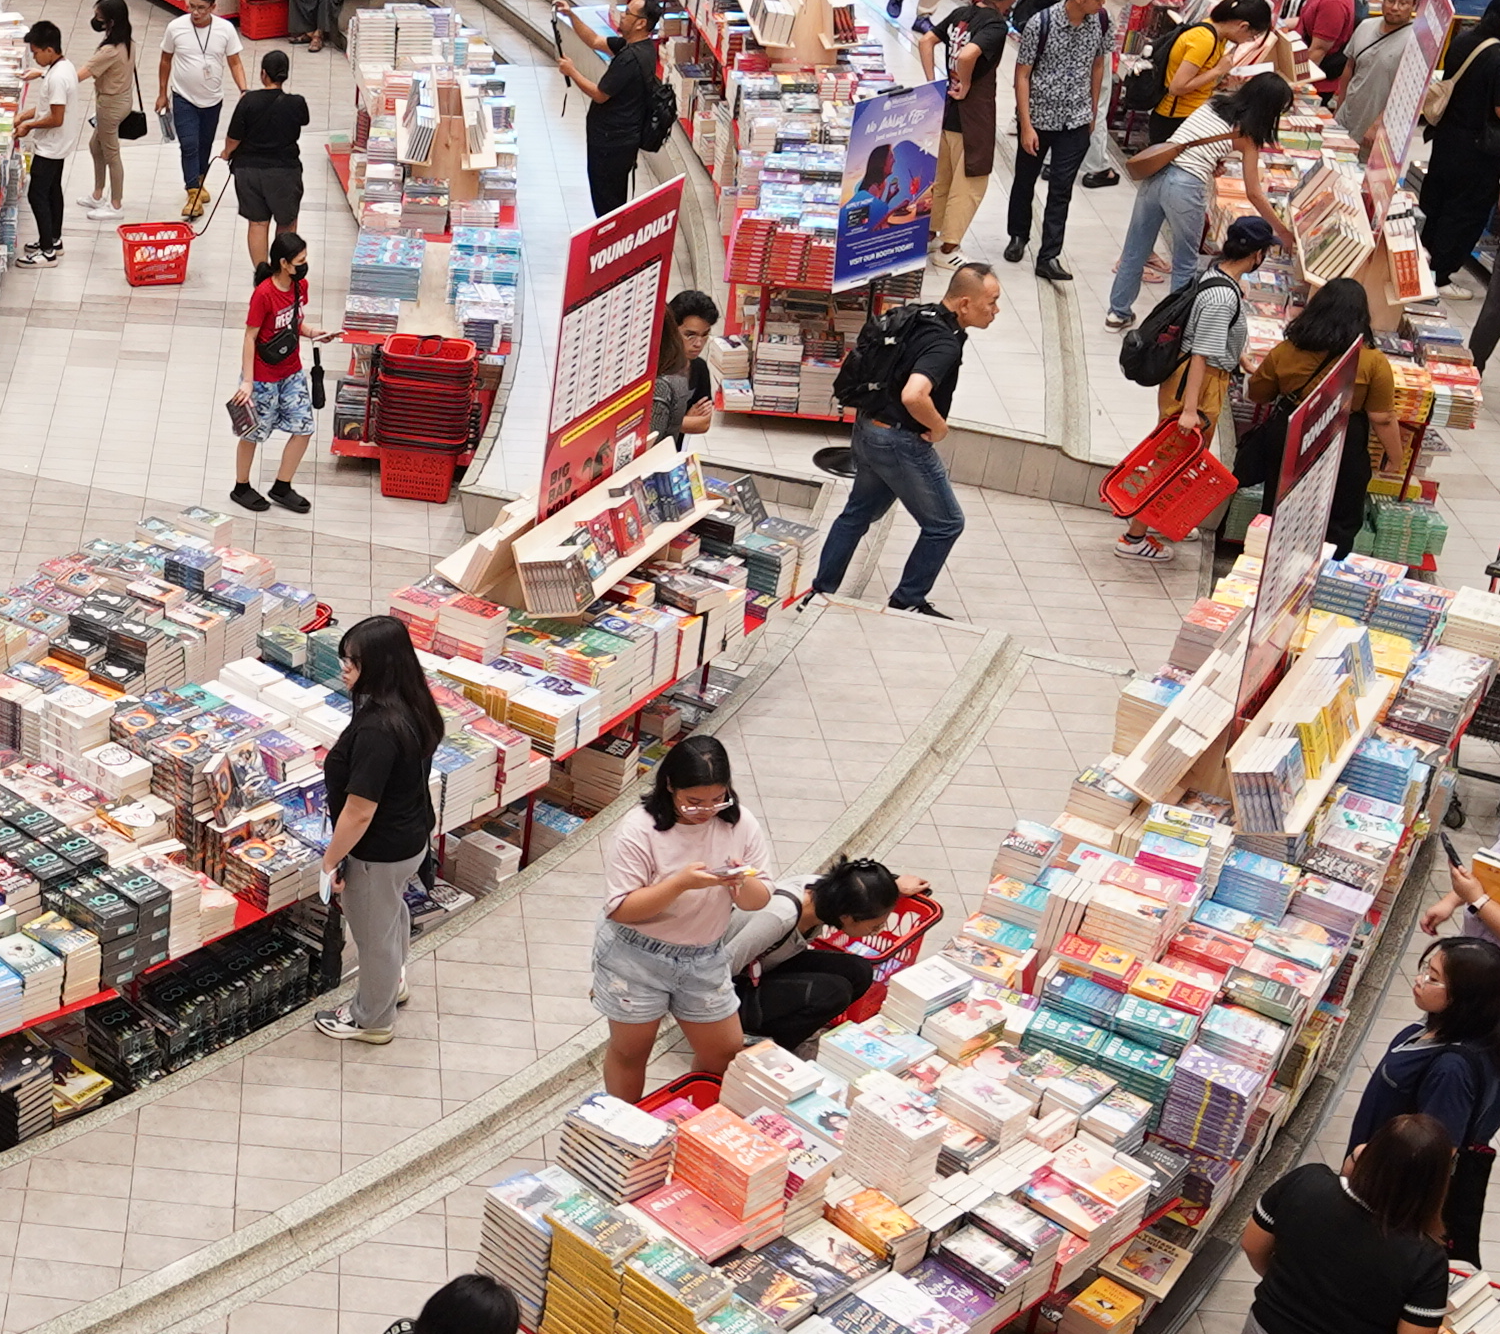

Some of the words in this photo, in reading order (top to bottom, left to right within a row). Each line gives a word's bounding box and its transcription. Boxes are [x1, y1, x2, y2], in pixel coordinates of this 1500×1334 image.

[590, 231, 635, 274] YOUNG
[634, 209, 677, 250] ADULT
[1301, 393, 1342, 456] ROMANCE
[593, 1219, 609, 1231] THE
[596, 1221, 623, 1242] RETURN
